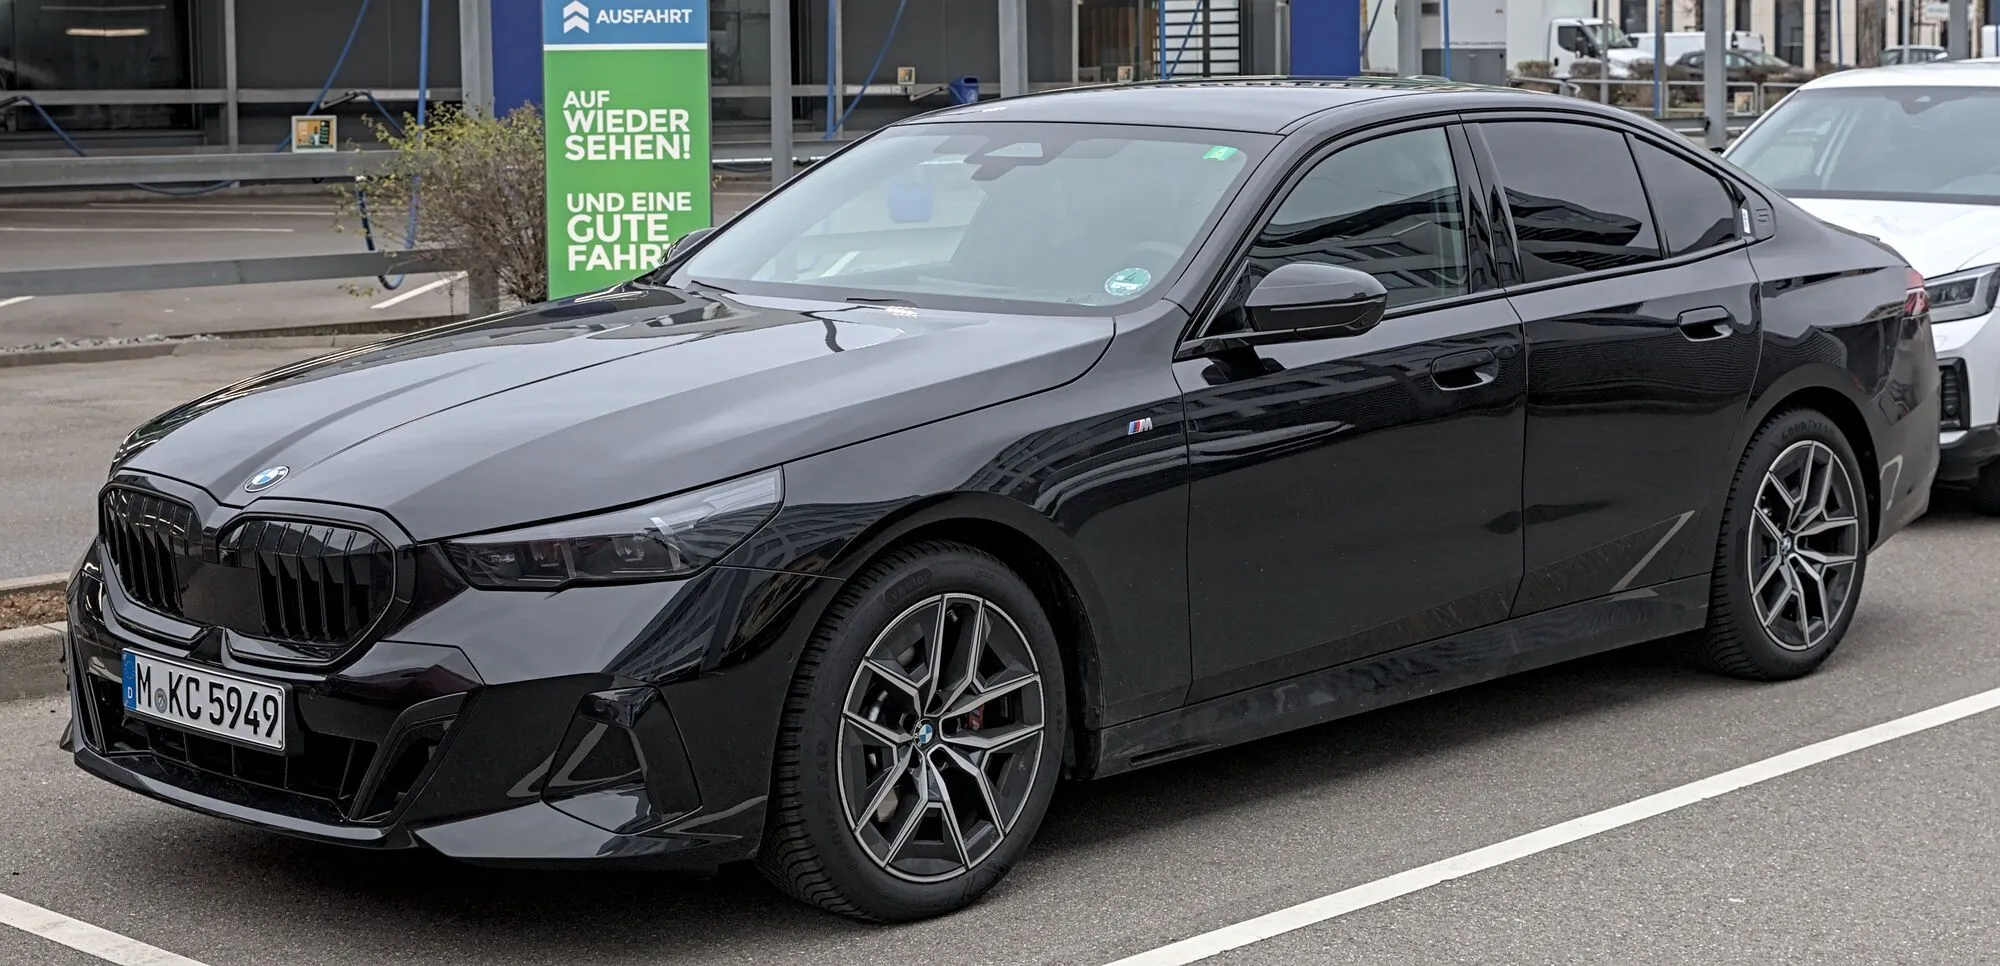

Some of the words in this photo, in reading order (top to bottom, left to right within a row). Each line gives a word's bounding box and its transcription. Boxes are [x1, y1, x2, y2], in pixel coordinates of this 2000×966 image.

[596, 9, 693, 24] AUSFAHRT
[563, 90, 610, 108] AUF
[563, 109, 690, 133] WIEDER
[565, 134, 691, 161] SEHEN!
[566, 192, 626, 213] UND
[632, 191, 692, 212] EINE
[567, 213, 669, 243] GUTE
[128, 687, 133, 699] D
[137, 662, 151, 708] M
[168, 671, 201, 720] KC
[208, 681, 279, 738] 5949
